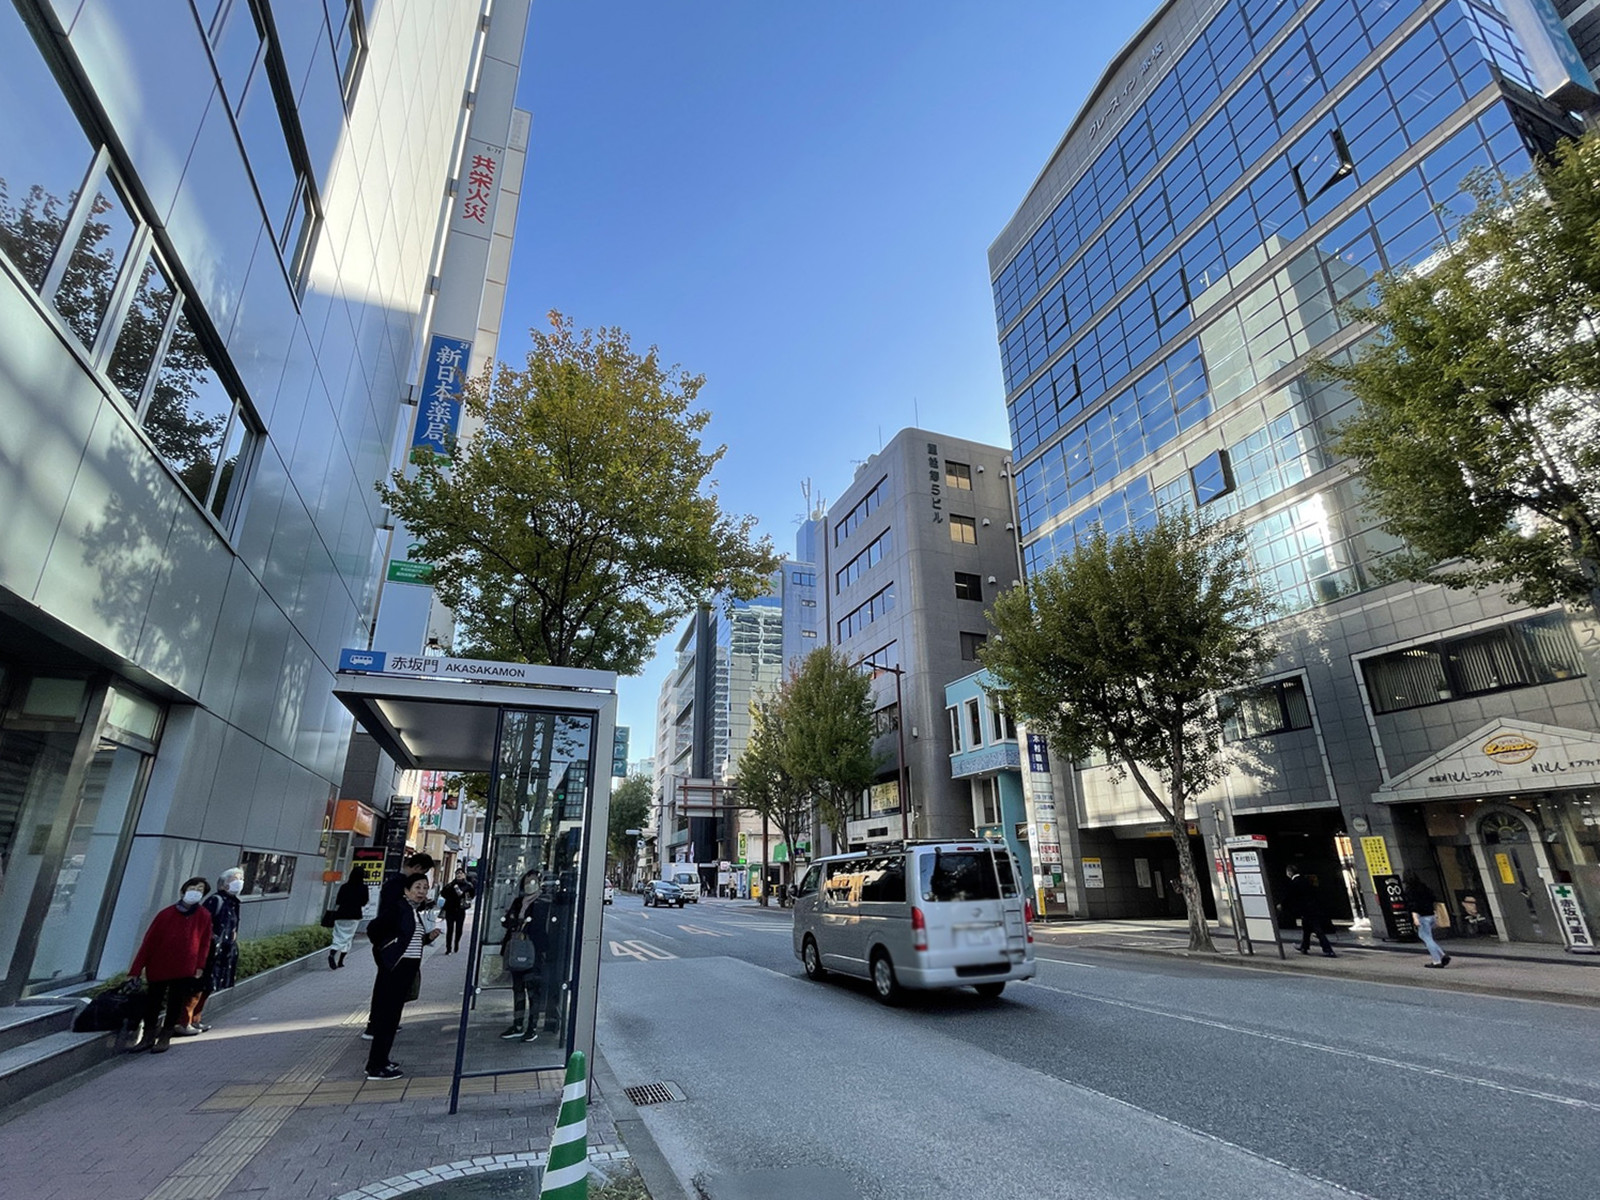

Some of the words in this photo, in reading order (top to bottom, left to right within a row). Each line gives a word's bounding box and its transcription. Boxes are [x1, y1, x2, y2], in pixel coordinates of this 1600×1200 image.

[463, 154, 496, 224] 共栄火災
[421, 345, 463, 445] 新日本薬局
[391, 656, 438, 673] 赤坂門
[445, 663, 526, 678] AKASAKAMON
[1559, 899, 1588, 944] 赤坂門薬局
[609, 939, 680, 962] 40
